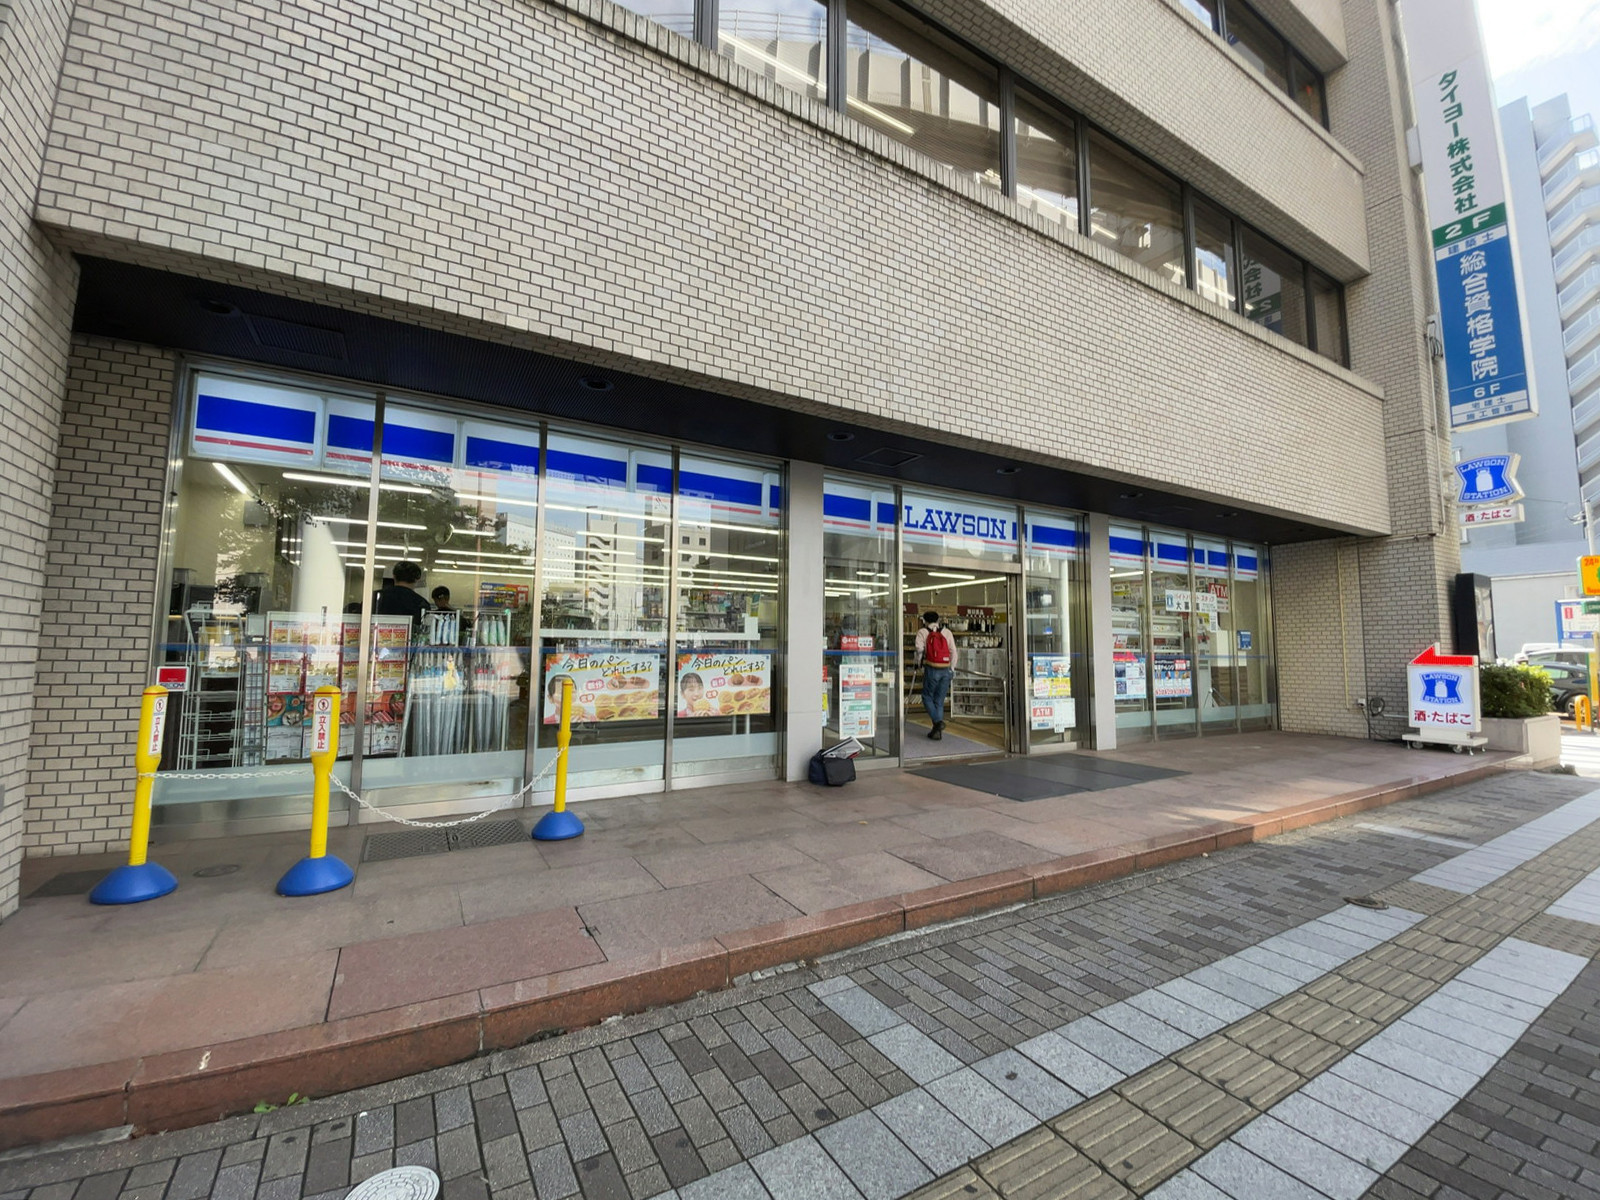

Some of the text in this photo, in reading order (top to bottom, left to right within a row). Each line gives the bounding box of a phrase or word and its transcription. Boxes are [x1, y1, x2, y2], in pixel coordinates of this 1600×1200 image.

[1438, 69, 1478, 215] タイヨー株式会社
[1448, 232, 1494, 255] 建築士
[1459, 250, 1499, 381] 総合資格学院
[1466, 404, 1514, 420] 施工管理
[1460, 458, 1505, 473] LAWSON
[1464, 487, 1508, 499] STATION
[903, 505, 1007, 539] LAWSON
[1465, 509, 1512, 522] 酒・たばこ
[1423, 673, 1459, 681] LAWSON
[1424, 695, 1459, 704] STATION
[1414, 709, 1471, 725] 酒・たばこ
[152, 716, 161, 752] 立入禁止
[317, 715, 327, 749] 立入禁止
